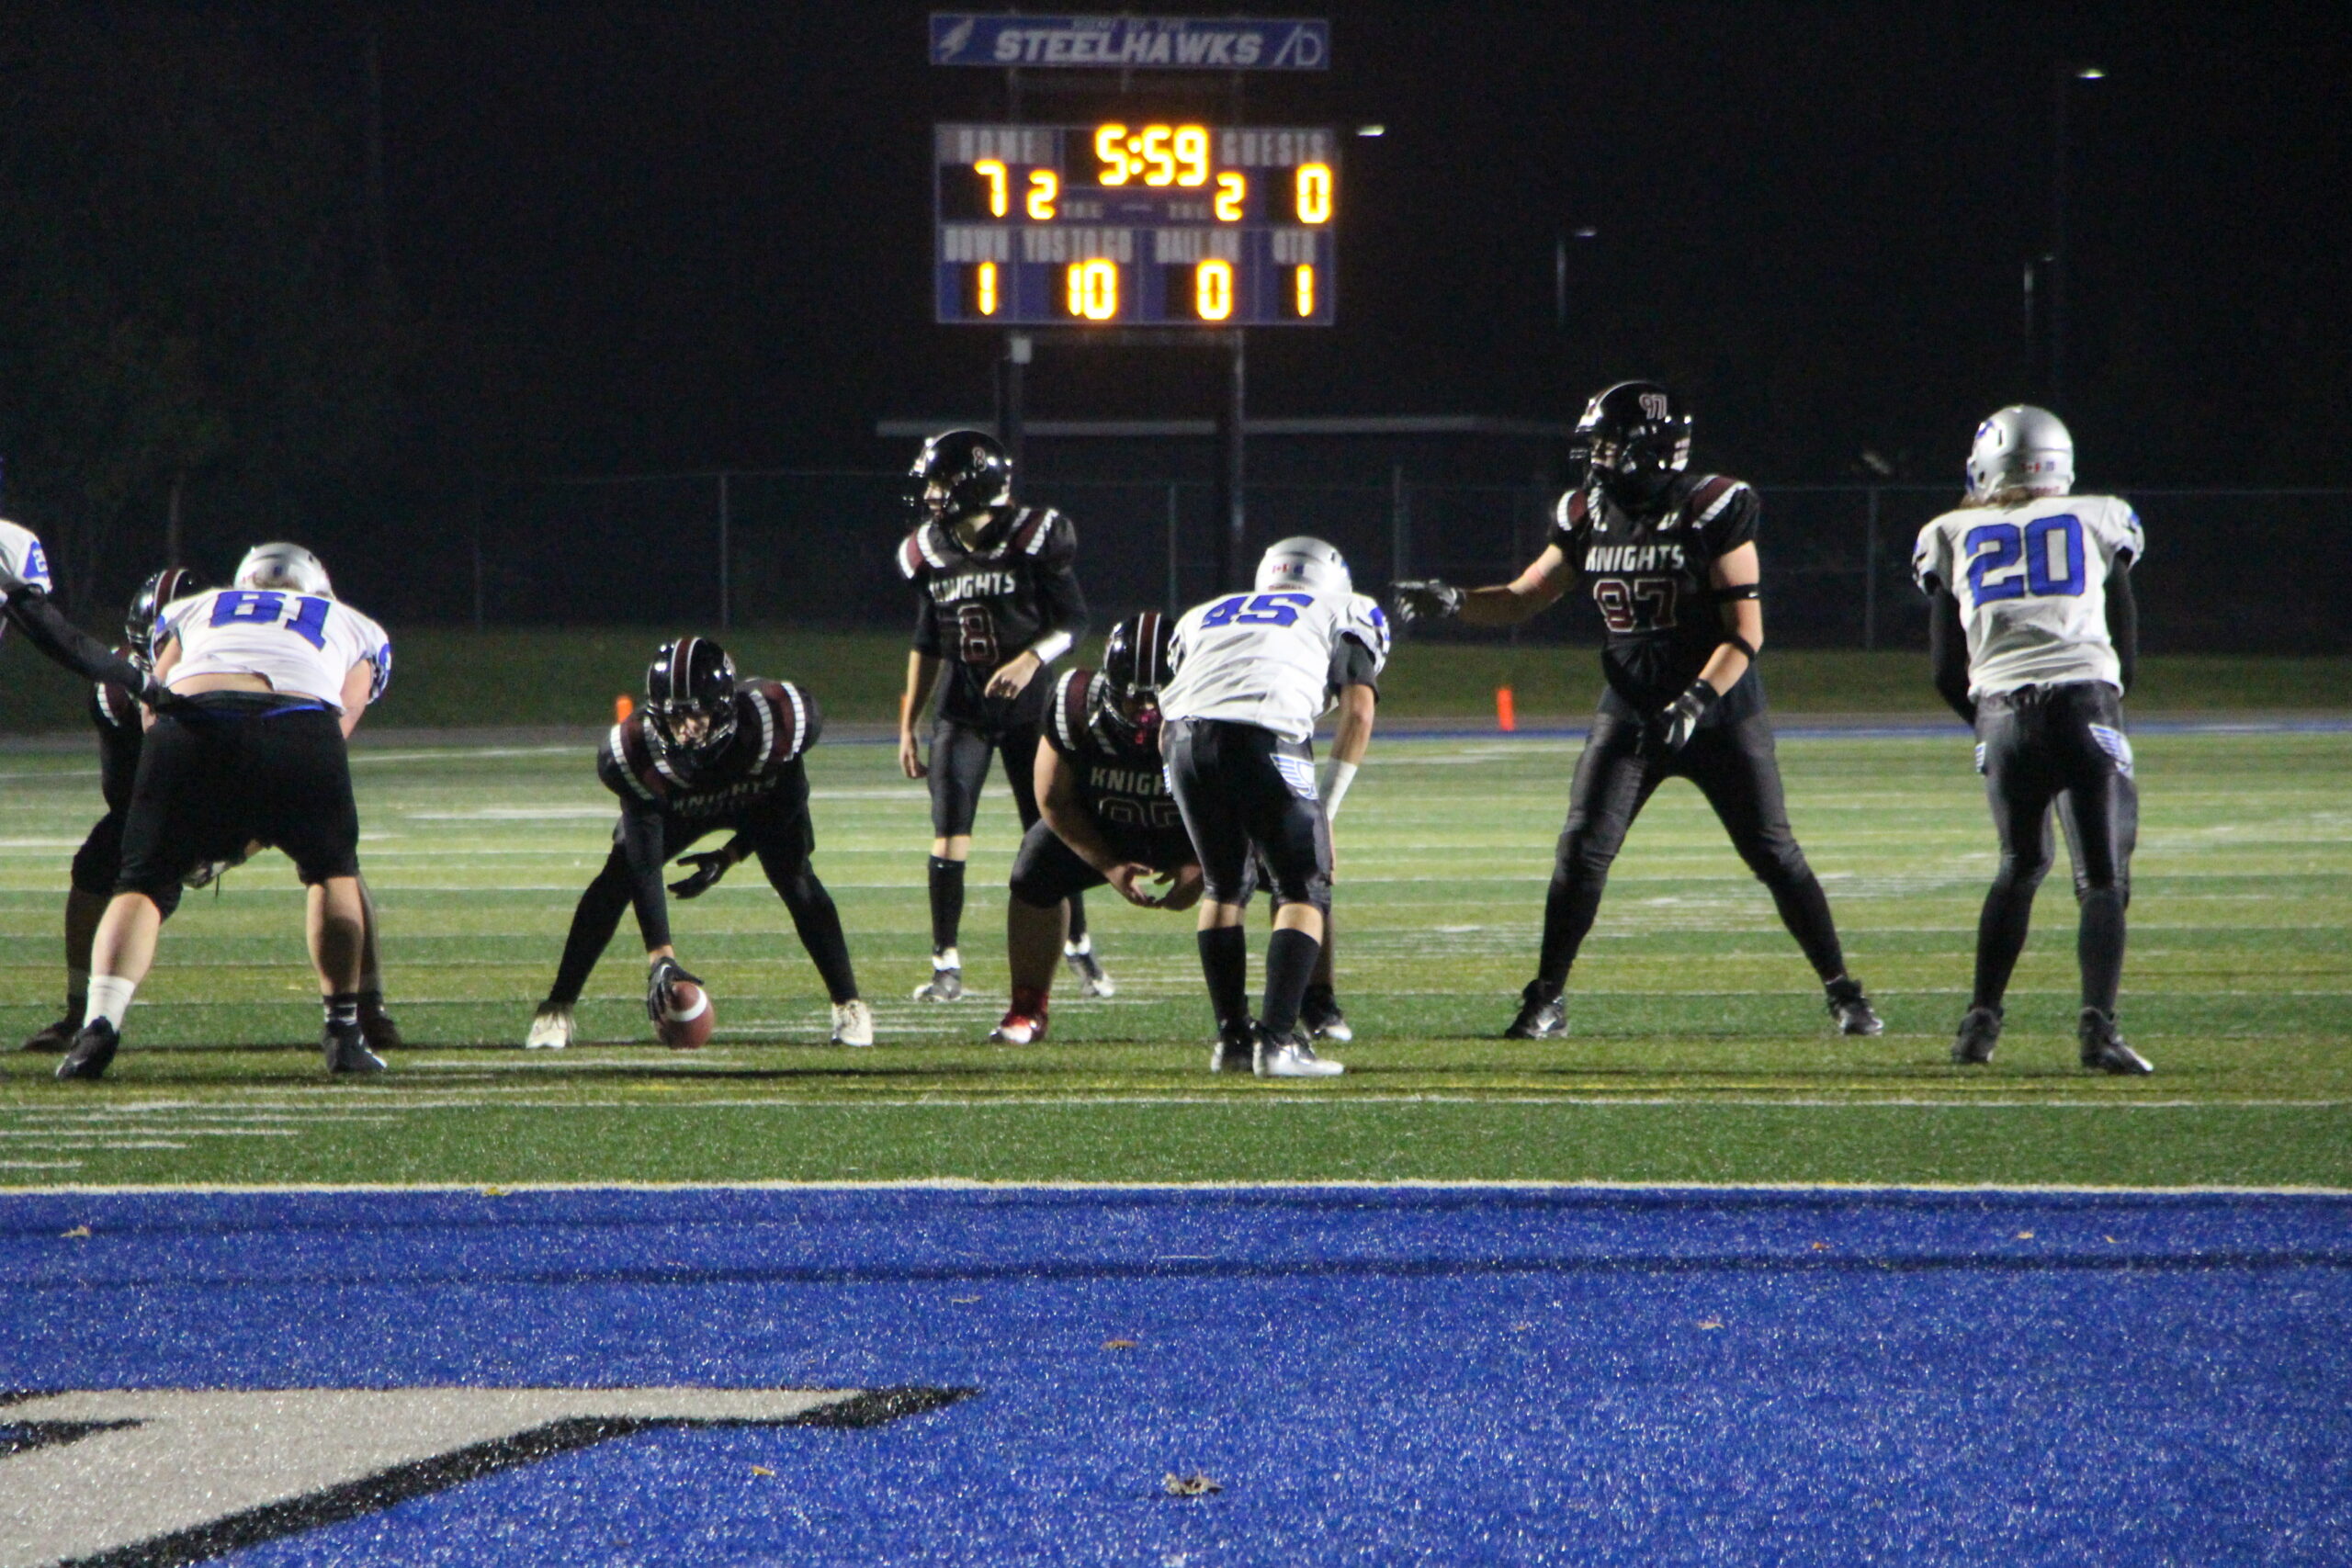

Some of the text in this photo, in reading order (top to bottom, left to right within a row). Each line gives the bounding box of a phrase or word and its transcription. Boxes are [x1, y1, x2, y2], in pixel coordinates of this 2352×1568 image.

[994, 30, 1263, 65] STEELHAWKS
[1095, 124, 1209, 186] 5:59
[974, 158, 1007, 218] 7
[1026, 169, 1057, 220] 2
[1215, 172, 1245, 221] 2
[1296, 163, 1331, 223] 0
[978, 261, 997, 315] 1
[1068, 258, 1117, 320] 10
[1197, 258, 1233, 320] 0
[1296, 263, 1314, 317] 1
[1585, 546, 1685, 571] KNIGHTS
[1965, 514, 2086, 608] 20
[1200, 593, 1315, 630] 45
[1593, 579, 1678, 632] 97
[957, 604, 1000, 665] 8
